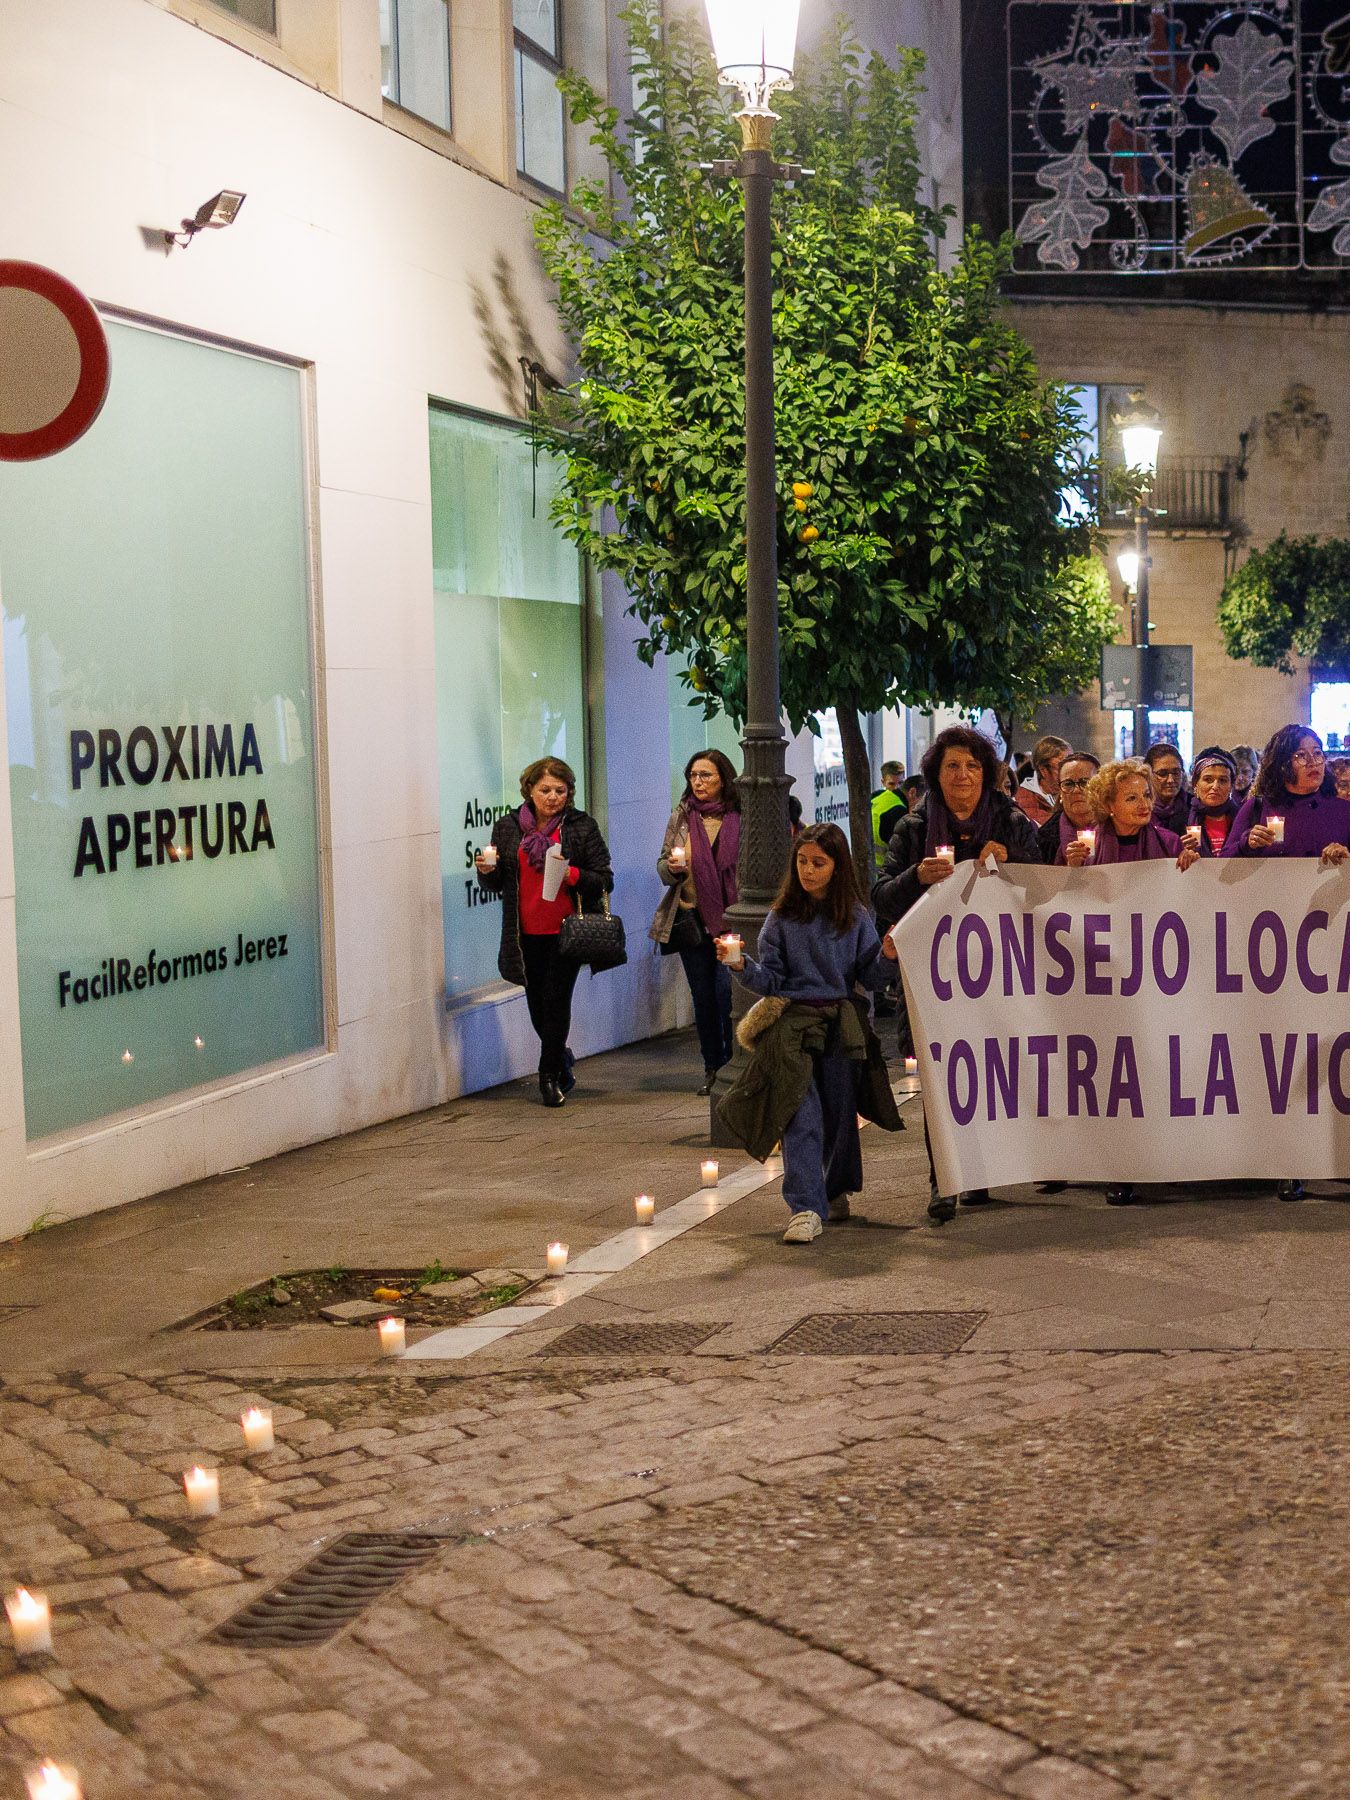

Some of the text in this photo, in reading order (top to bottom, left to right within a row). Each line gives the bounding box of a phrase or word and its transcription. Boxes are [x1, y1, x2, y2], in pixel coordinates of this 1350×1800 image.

[70, 723, 264, 790] PROXIMA
[73, 798, 276, 878] APERTURA
[58, 933, 289, 1009] FacilReformas Jerez
[930, 911, 1190, 1003] CONSEJO
[929, 1034, 1145, 1127] ONTRA
[1169, 1033, 1240, 1118] LA
